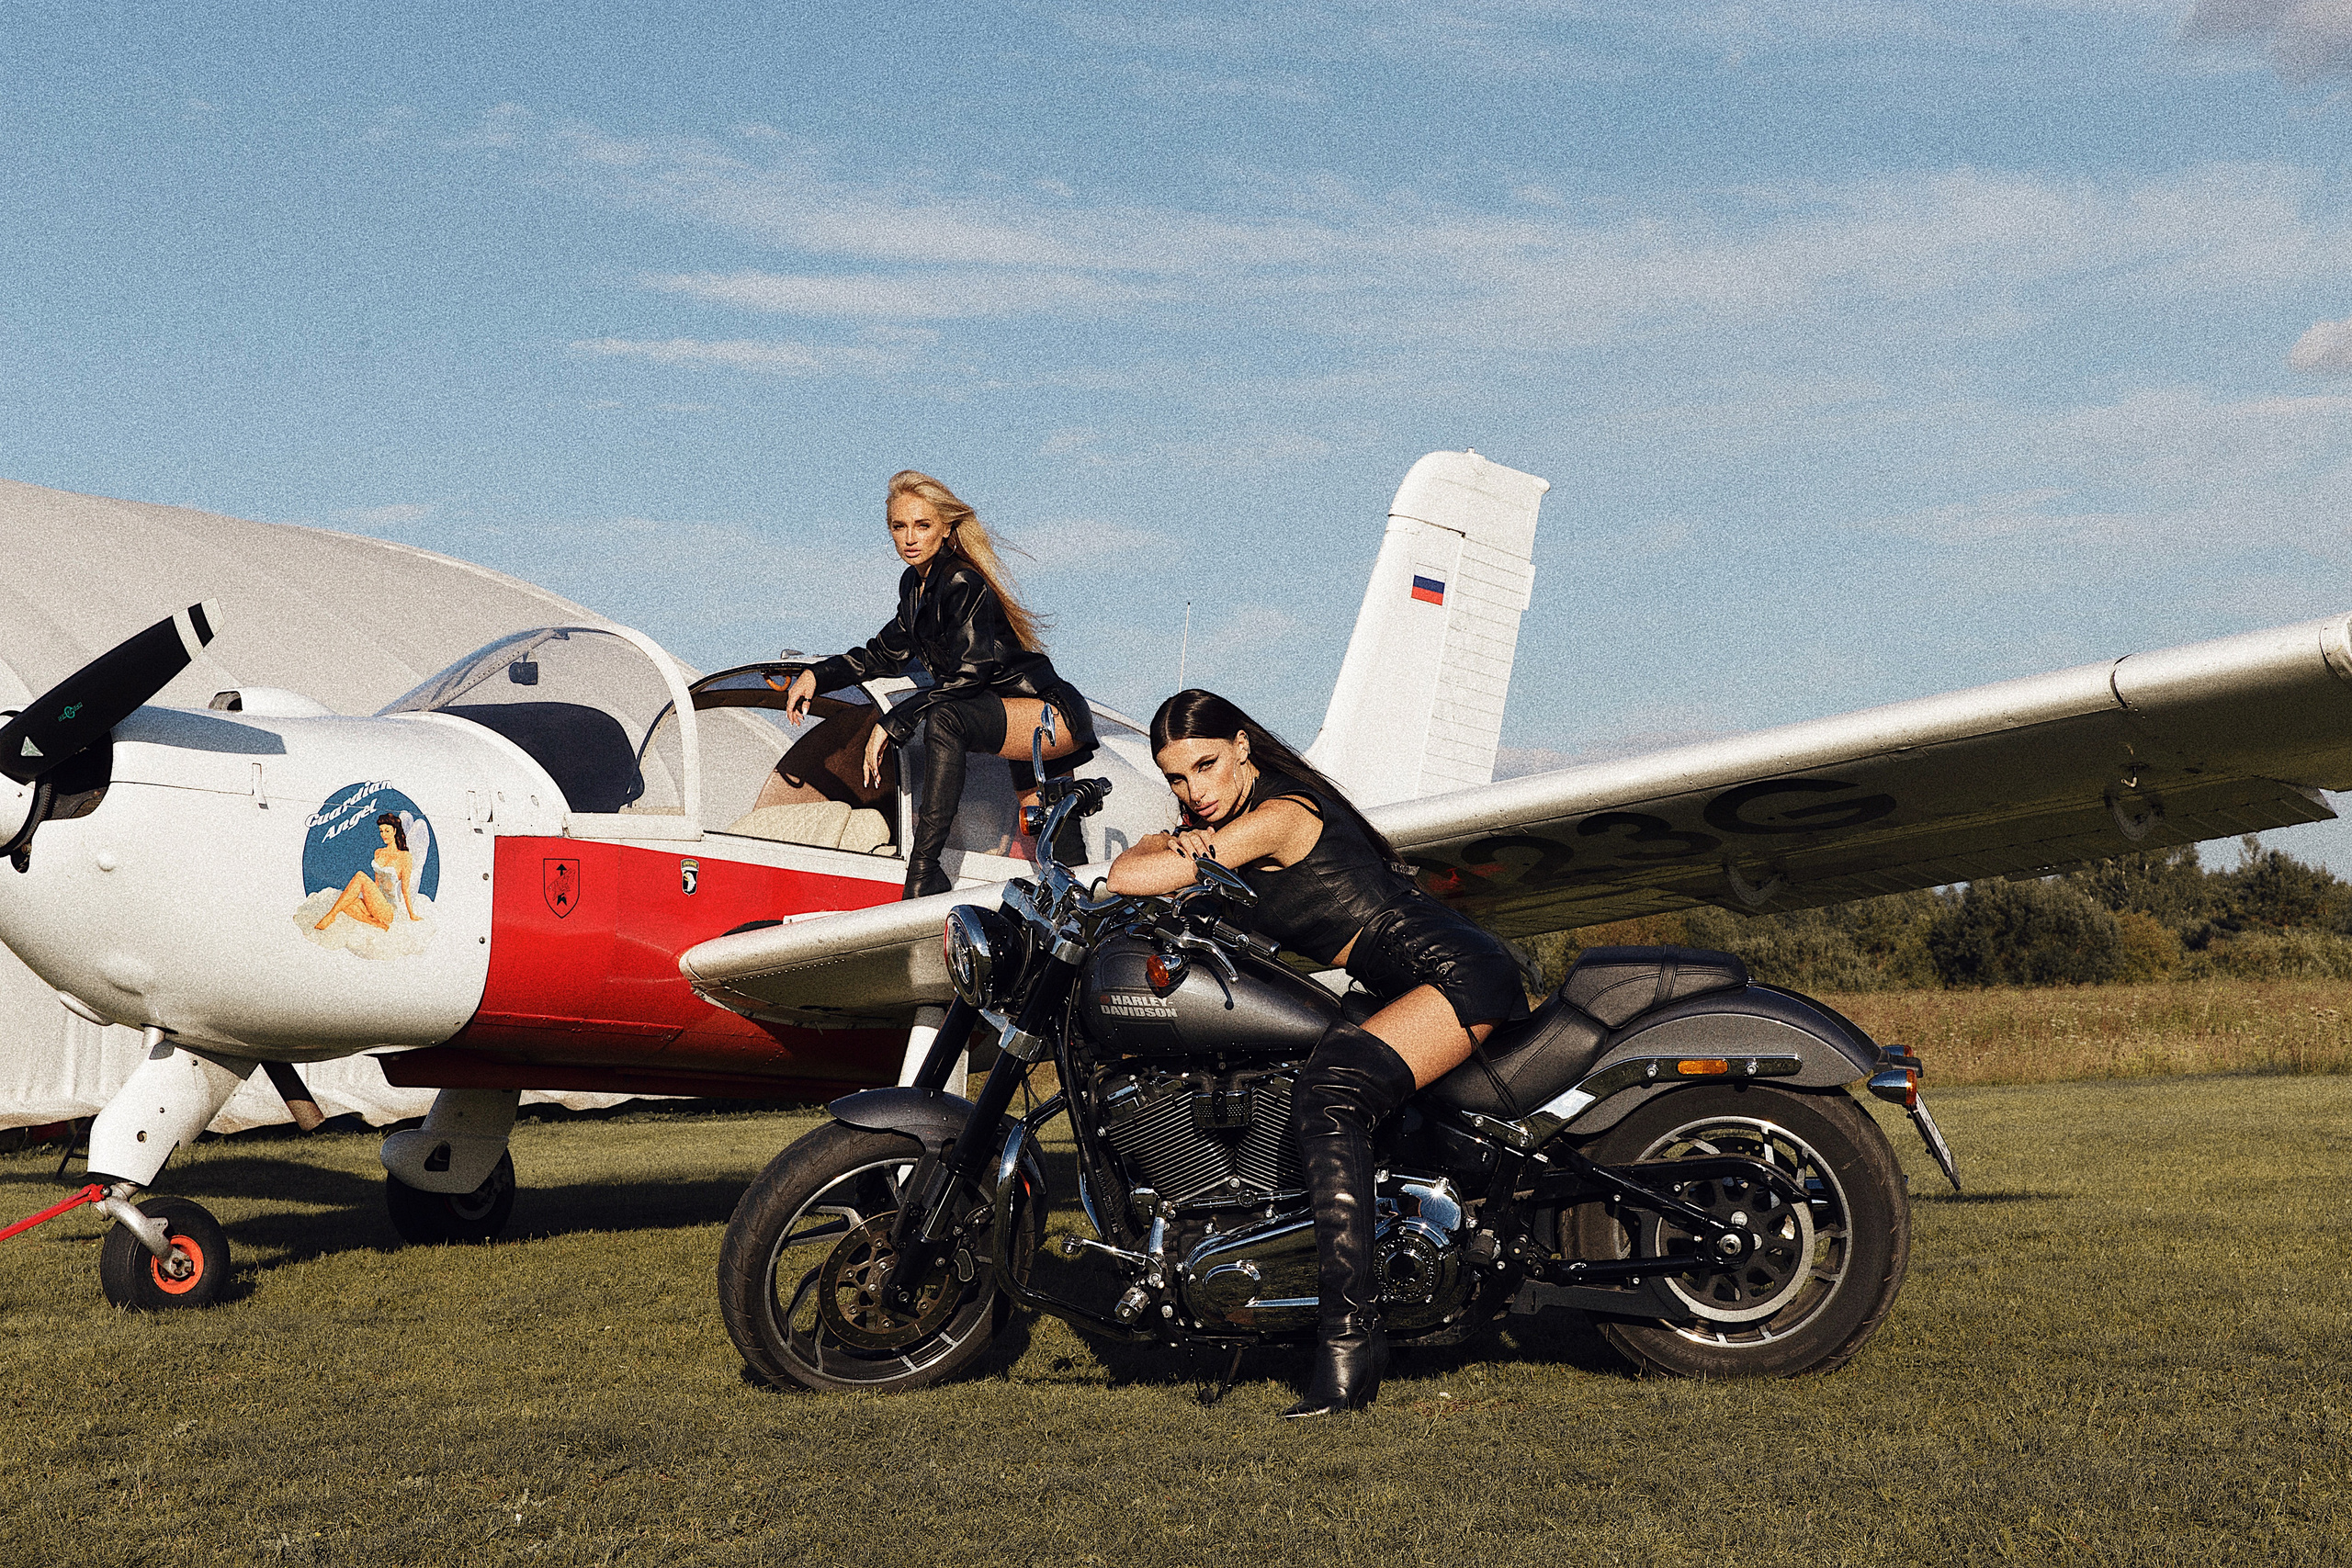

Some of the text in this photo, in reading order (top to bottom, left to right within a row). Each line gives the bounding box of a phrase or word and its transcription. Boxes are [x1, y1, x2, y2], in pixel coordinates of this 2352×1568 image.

[304, 779, 393, 829] Guardian
[321, 797, 378, 844] Angel
[1100, 1004, 1179, 1018] DAVIDSON
[1110, 994, 1174, 1007] HARLEY-
